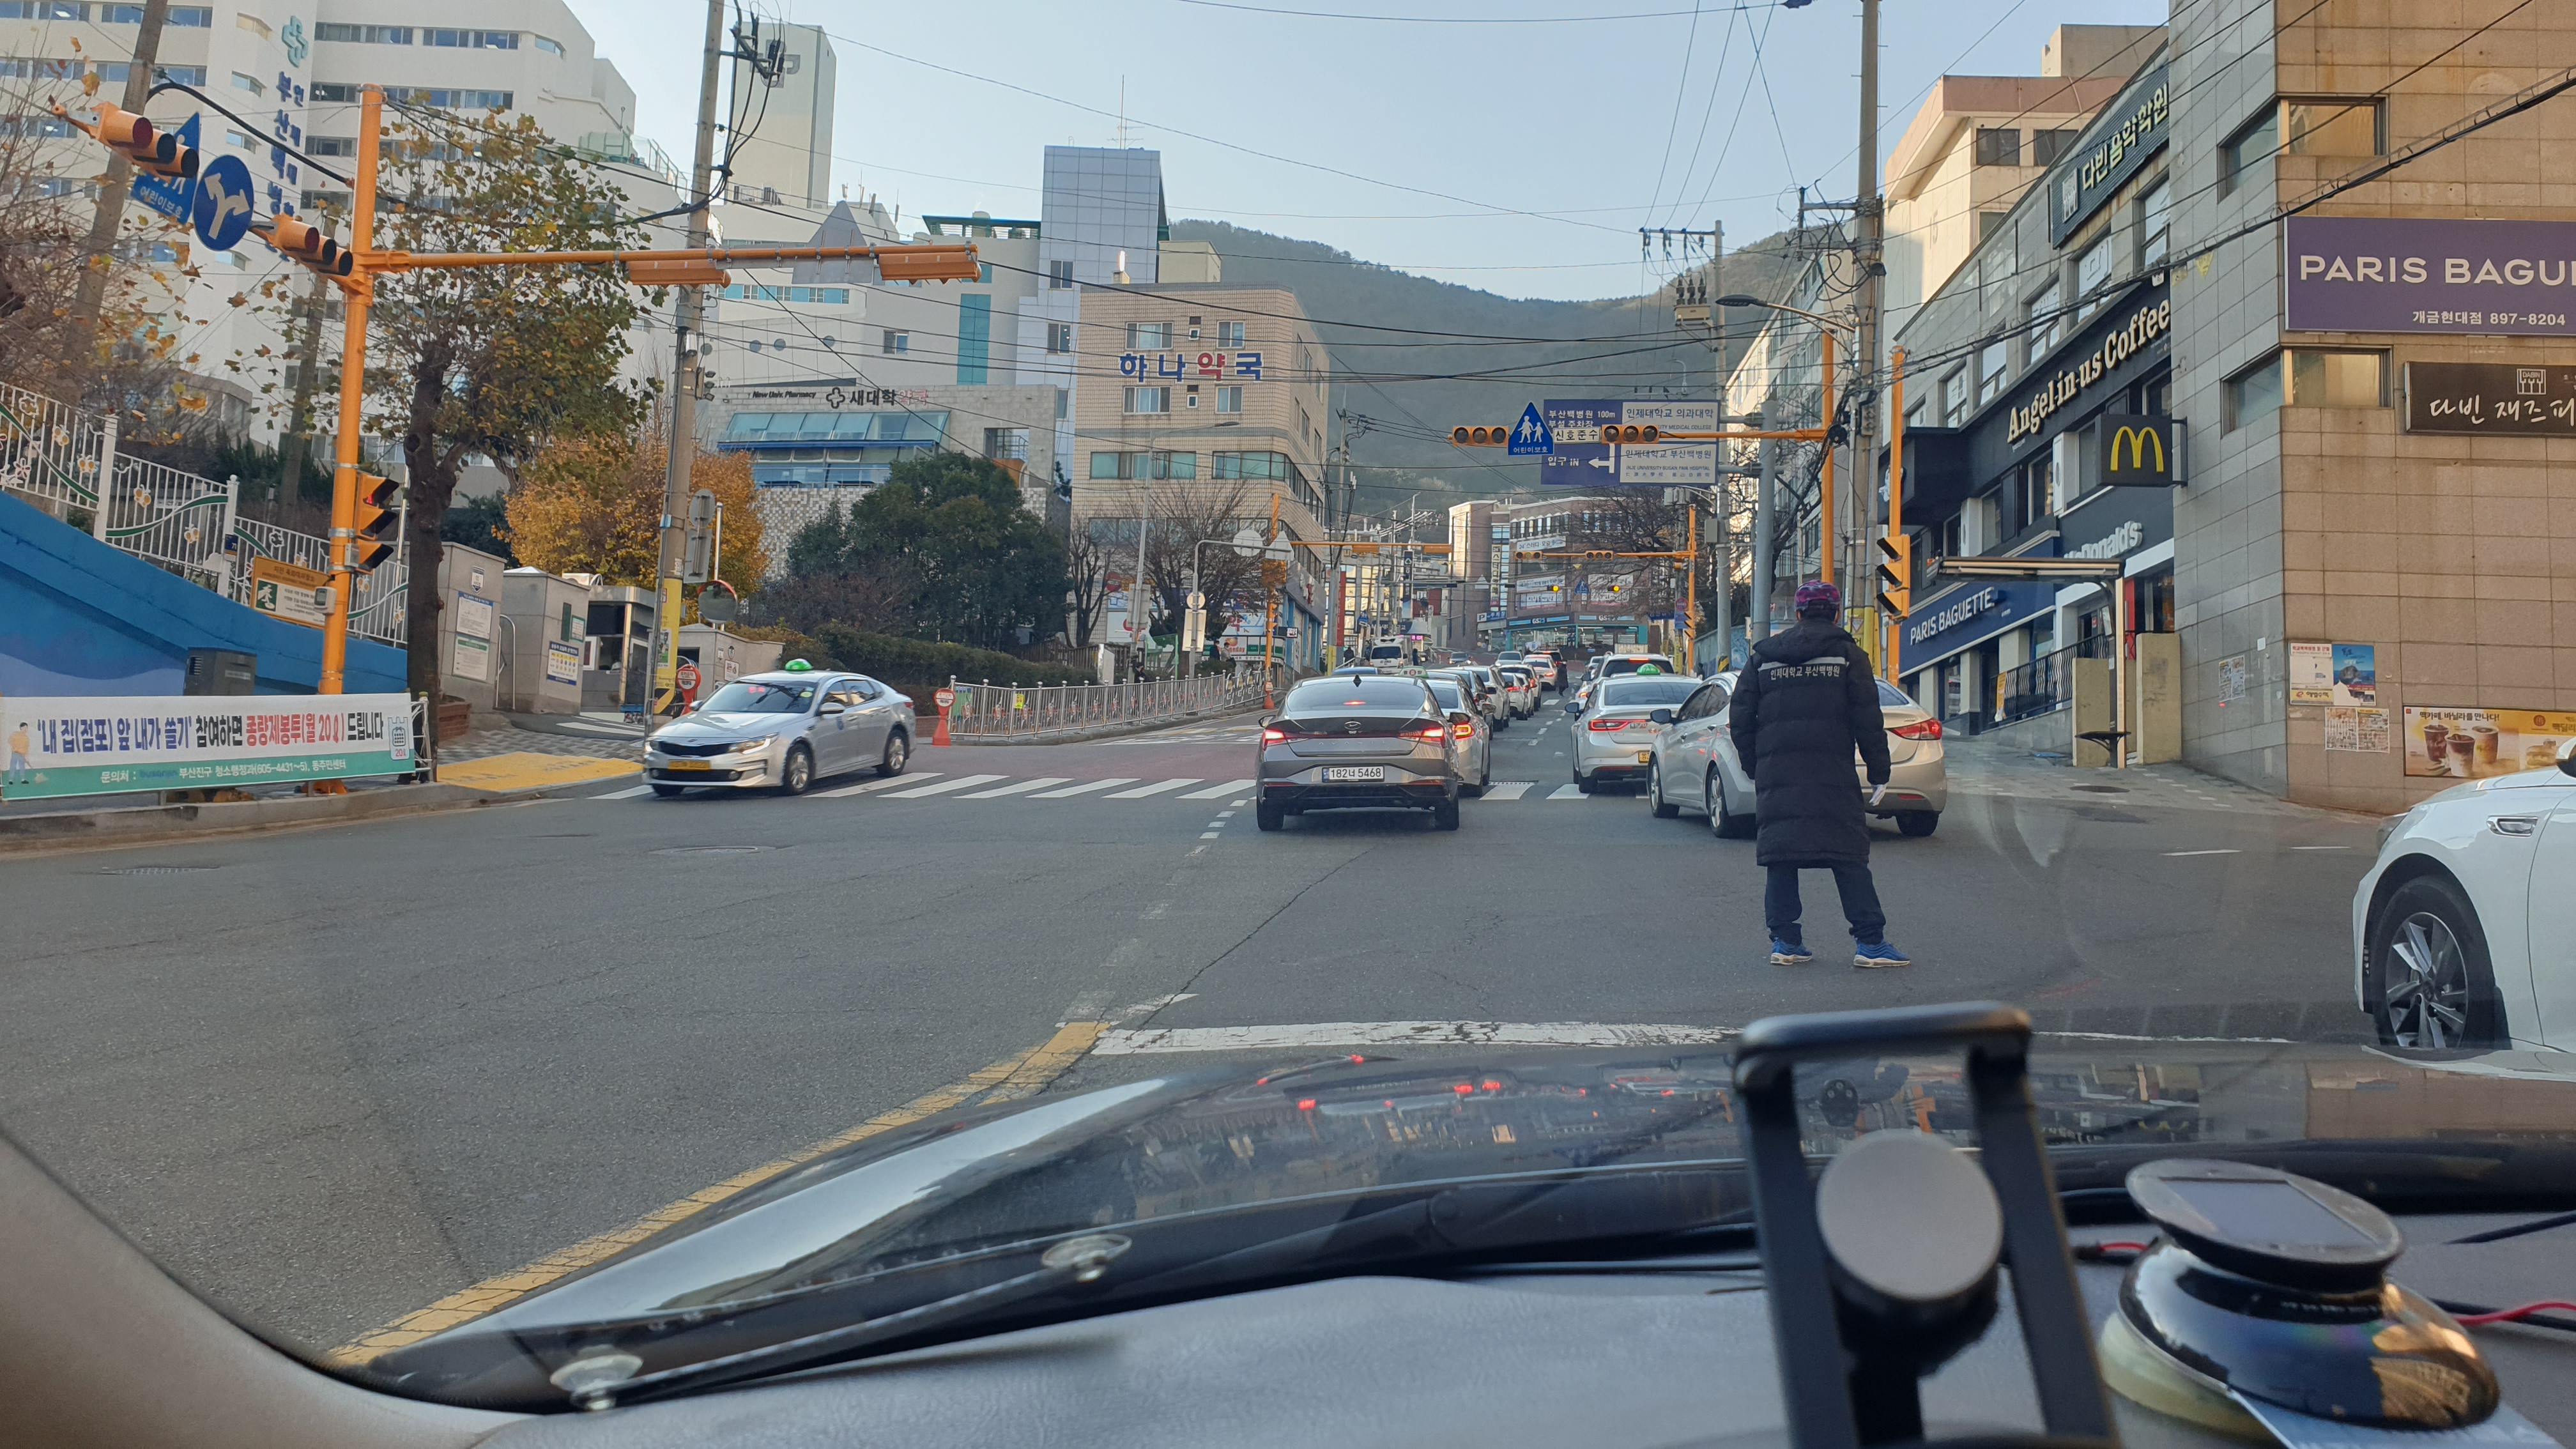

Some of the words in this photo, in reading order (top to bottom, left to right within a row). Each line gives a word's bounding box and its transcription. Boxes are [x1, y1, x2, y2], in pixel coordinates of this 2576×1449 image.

[2083, 82, 2169, 191] 다빈음악학원
[140, 186, 183, 218] 어린이보호
[2299, 254, 2428, 283] PARIS
[2445, 258, 2576, 286] BAGU
[2412, 310, 2482, 325] 개금현대점
[2490, 311, 2566, 326] 897-8204
[1120, 352, 1262, 383] 하나약국
[2007, 350, 2103, 443] Angel-in-us
[2104, 298, 2171, 369] Coffee
[1549, 410, 1593, 419] 부산백병원
[1627, 408, 1673, 419] 인제대학교
[1676, 408, 1713, 419] 의과대학
[2430, 394, 2485, 424] 다빈
[1555, 429, 1598, 441] 신호준수
[1547, 457, 1566, 466] 입구
[1625, 450, 1667, 459] 인제대학교
[1670, 450, 1712, 459] 부산백병원
[1910, 615, 1938, 645] PARIS
[1938, 586, 1995, 632] BAGUETTE
[1770, 666, 1803, 681] 인제대학교
[1804, 665, 1840, 678] 부산백병원
[2444, 712, 2473, 721] 바닐라를
[2474, 713, 2500, 722] 만나다!
[61, 717, 114, 753] 집(점포)
[116, 717, 131, 751] 앞
[134, 717, 162, 751] 내가
[195, 714, 243, 747] 참여하면
[246, 712, 316, 747] 종량제봉투(월
[347, 712, 383, 741] 드립니다
[100, 770, 129, 783] 문의처
[179, 766, 213, 779] 부산진구
[312, 758, 346, 772] 동주민센터
[1331, 769, 1355, 778] 182너
[1358, 768, 1381, 778] 5468
